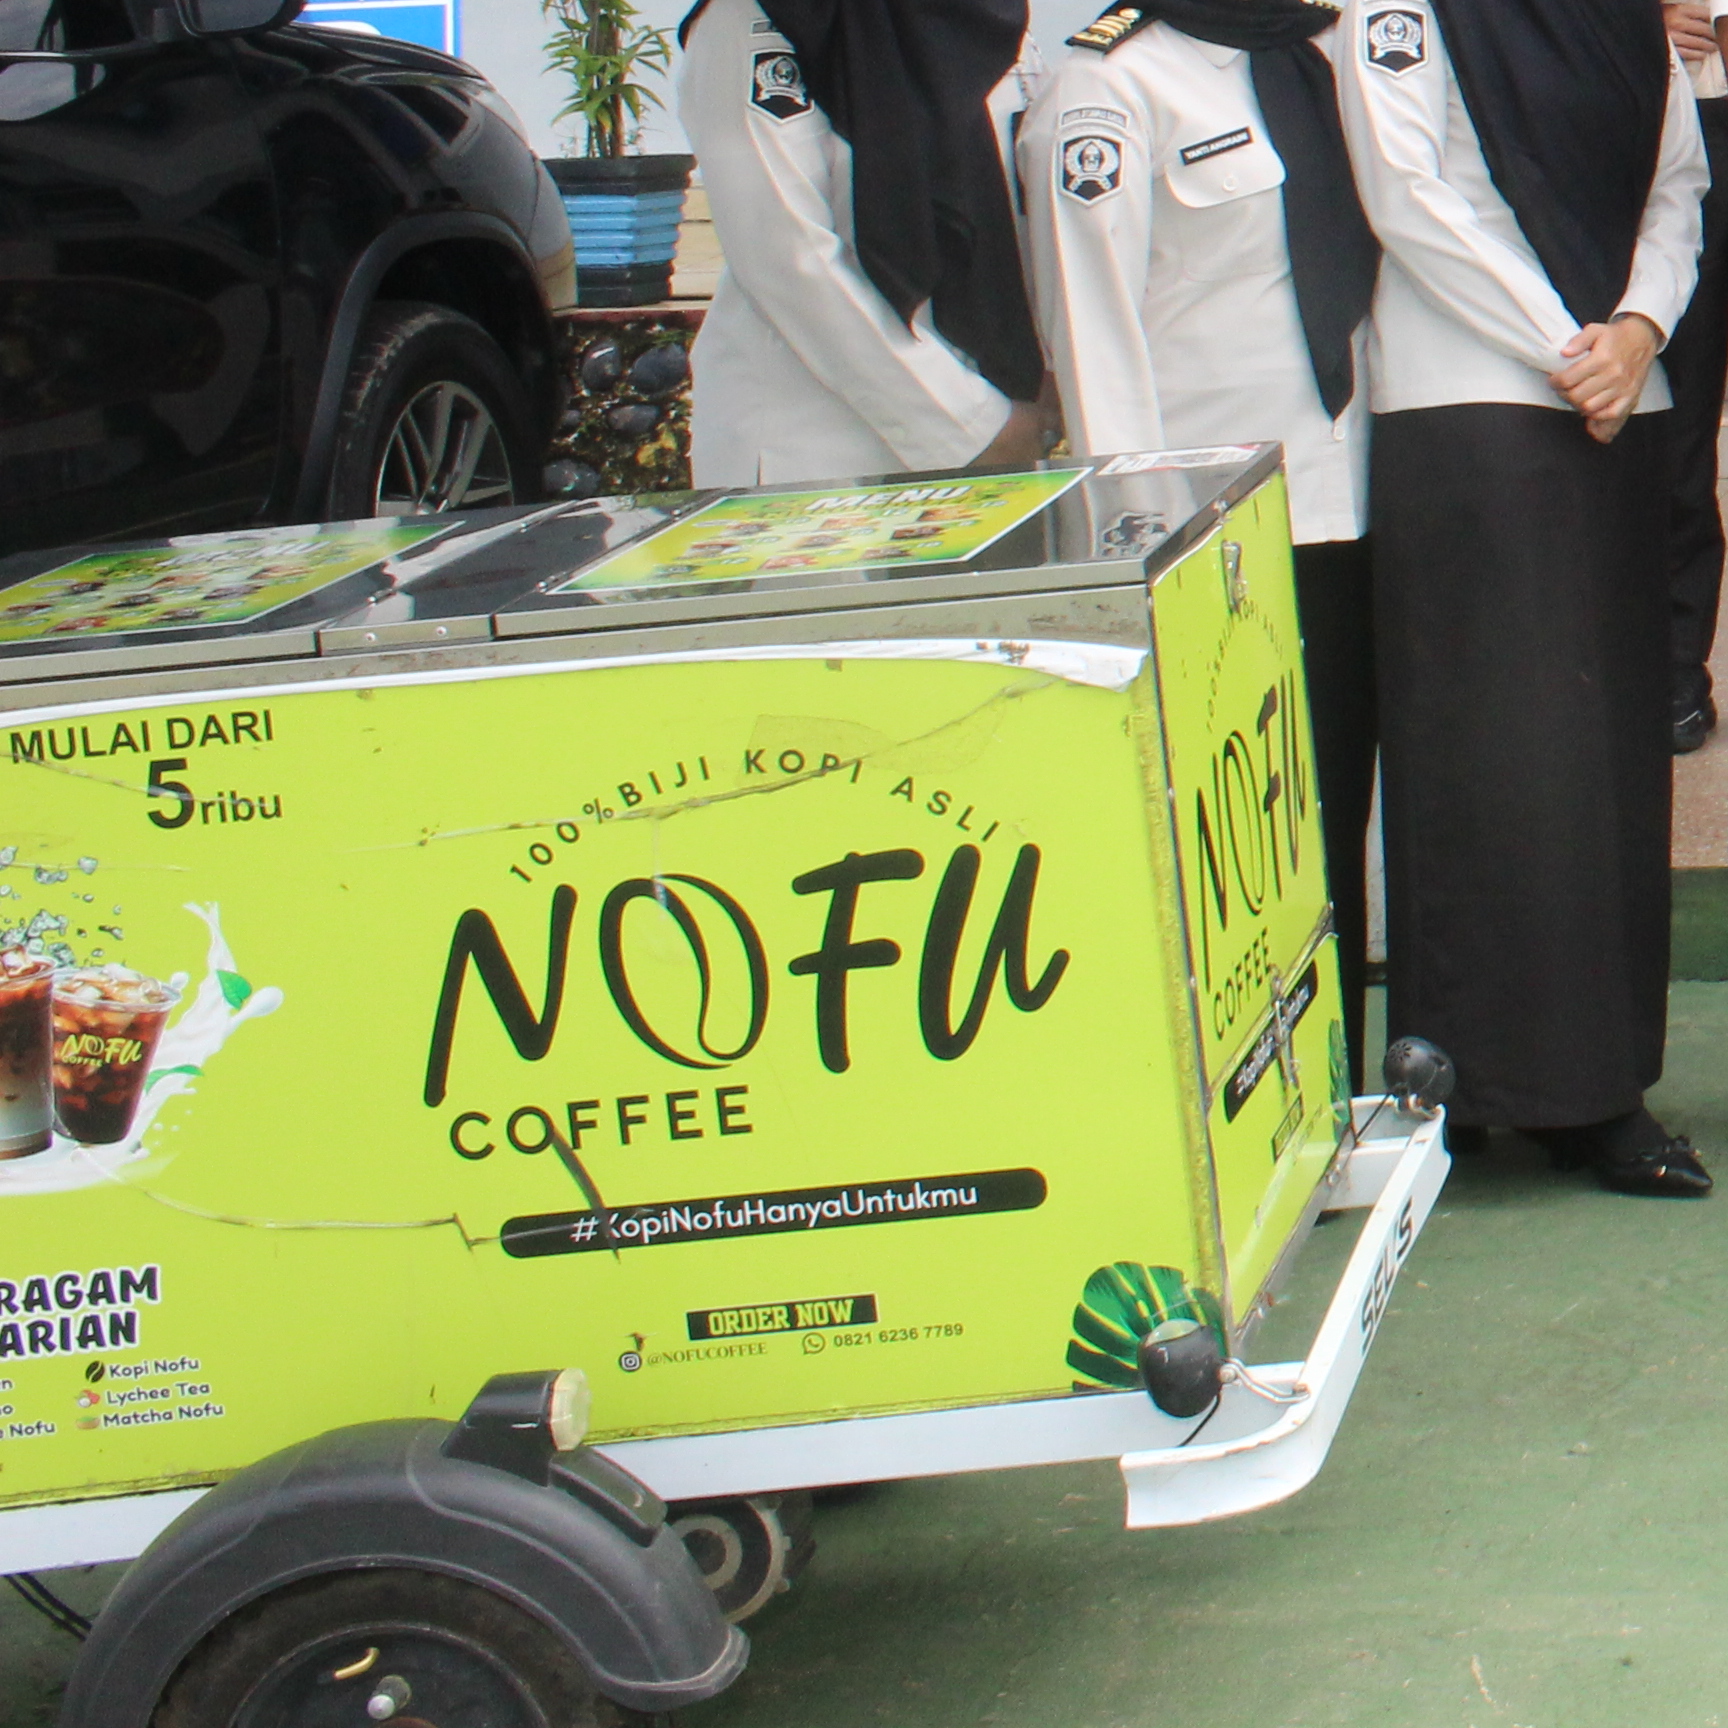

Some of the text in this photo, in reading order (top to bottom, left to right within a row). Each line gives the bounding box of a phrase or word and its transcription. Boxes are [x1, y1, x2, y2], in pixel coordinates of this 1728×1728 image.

[10, 708, 275, 765] MULAI DARI
[146, 756, 283, 829] 5 ribu
[744, 748, 865, 784] KOPI
[890, 775, 1001, 843] ASLI
[423, 843, 1071, 1108] NOFU
[61, 1033, 142, 1066] NOFU
[62, 1054, 103, 1068] COFFEE
[448, 1083, 754, 1161] COFFEE
[708, 1298, 855, 1337] ORDER NOW
[646, 1341, 768, 1368] @NOFUCOFFEE
[832, 1331, 873, 1349] 0821
[923, 1322, 964, 1340] 7789
[109, 1355, 200, 1380] Kopi Nofu
[106, 1381, 211, 1407] Lychee Tea
[10, 1419, 56, 1438] Nofu
[103, 1403, 224, 1428] Matcha Nofu
